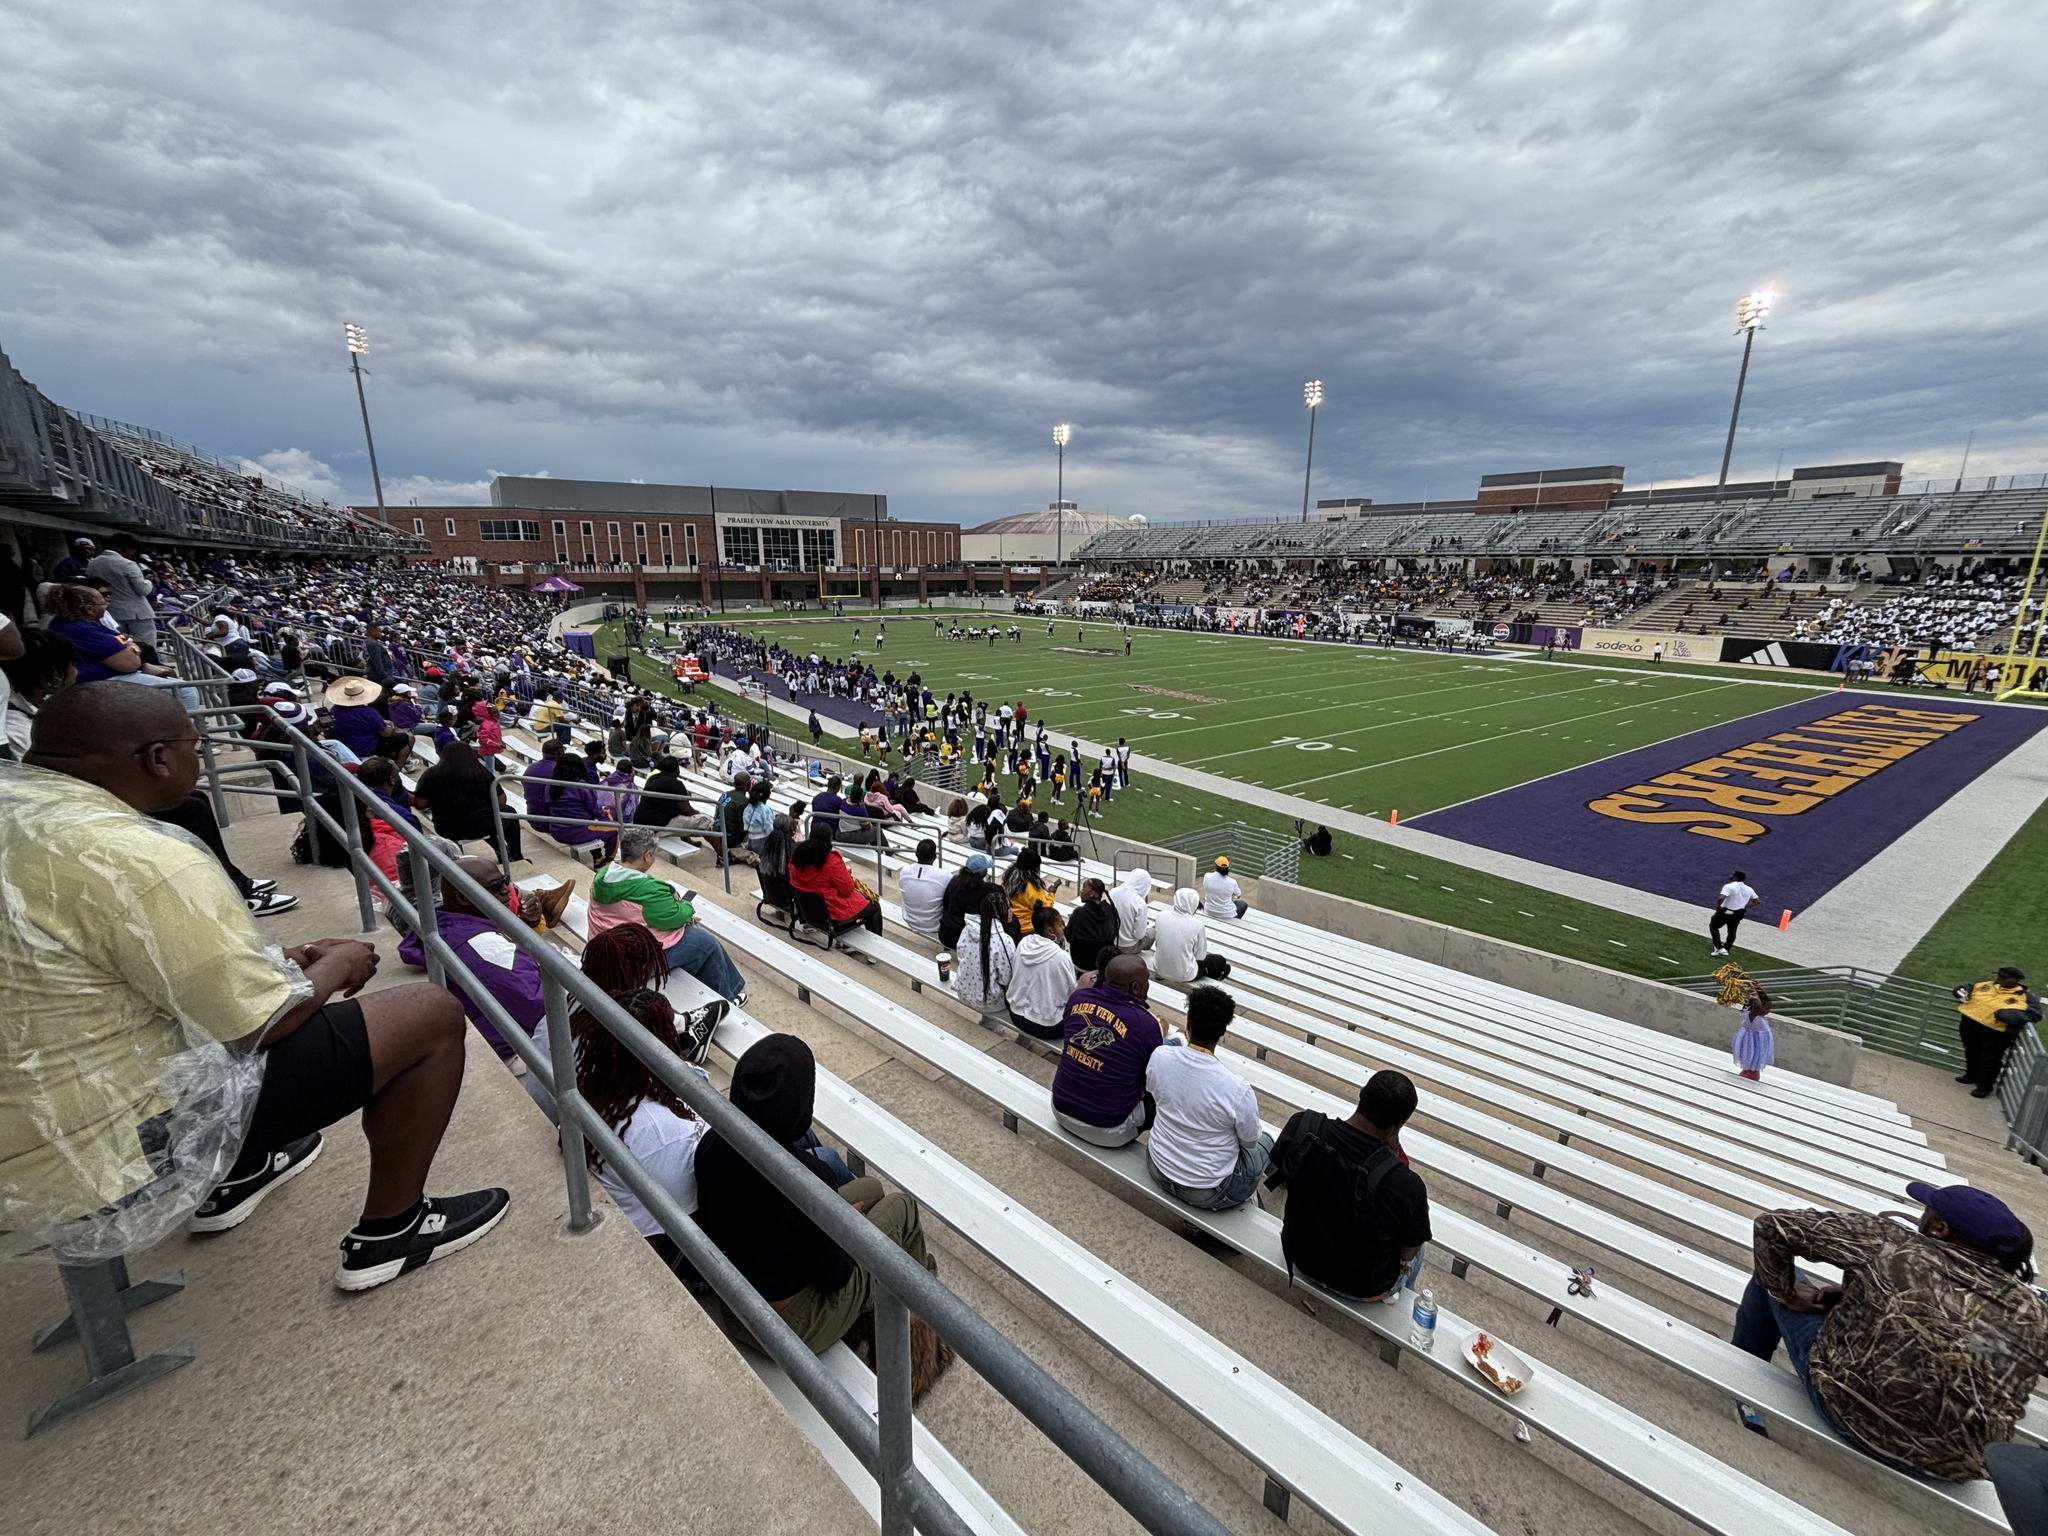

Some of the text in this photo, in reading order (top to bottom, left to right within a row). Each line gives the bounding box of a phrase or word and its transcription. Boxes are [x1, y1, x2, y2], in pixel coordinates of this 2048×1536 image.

[1595, 641, 1643, 652] sodexo
[1119, 707, 1180, 719] 20
[1270, 736, 1333, 751] 10
[1587, 704, 1982, 844] PANTHERS
[1070, 1003, 1097, 1015] PRAIRIE
[1096, 1006, 1116, 1024] VIEW
[694, 1022, 709, 1040] N
[1066, 1044, 1104, 1071] UNIVERSITY
[1394, 1482, 1404, 1492] 5
